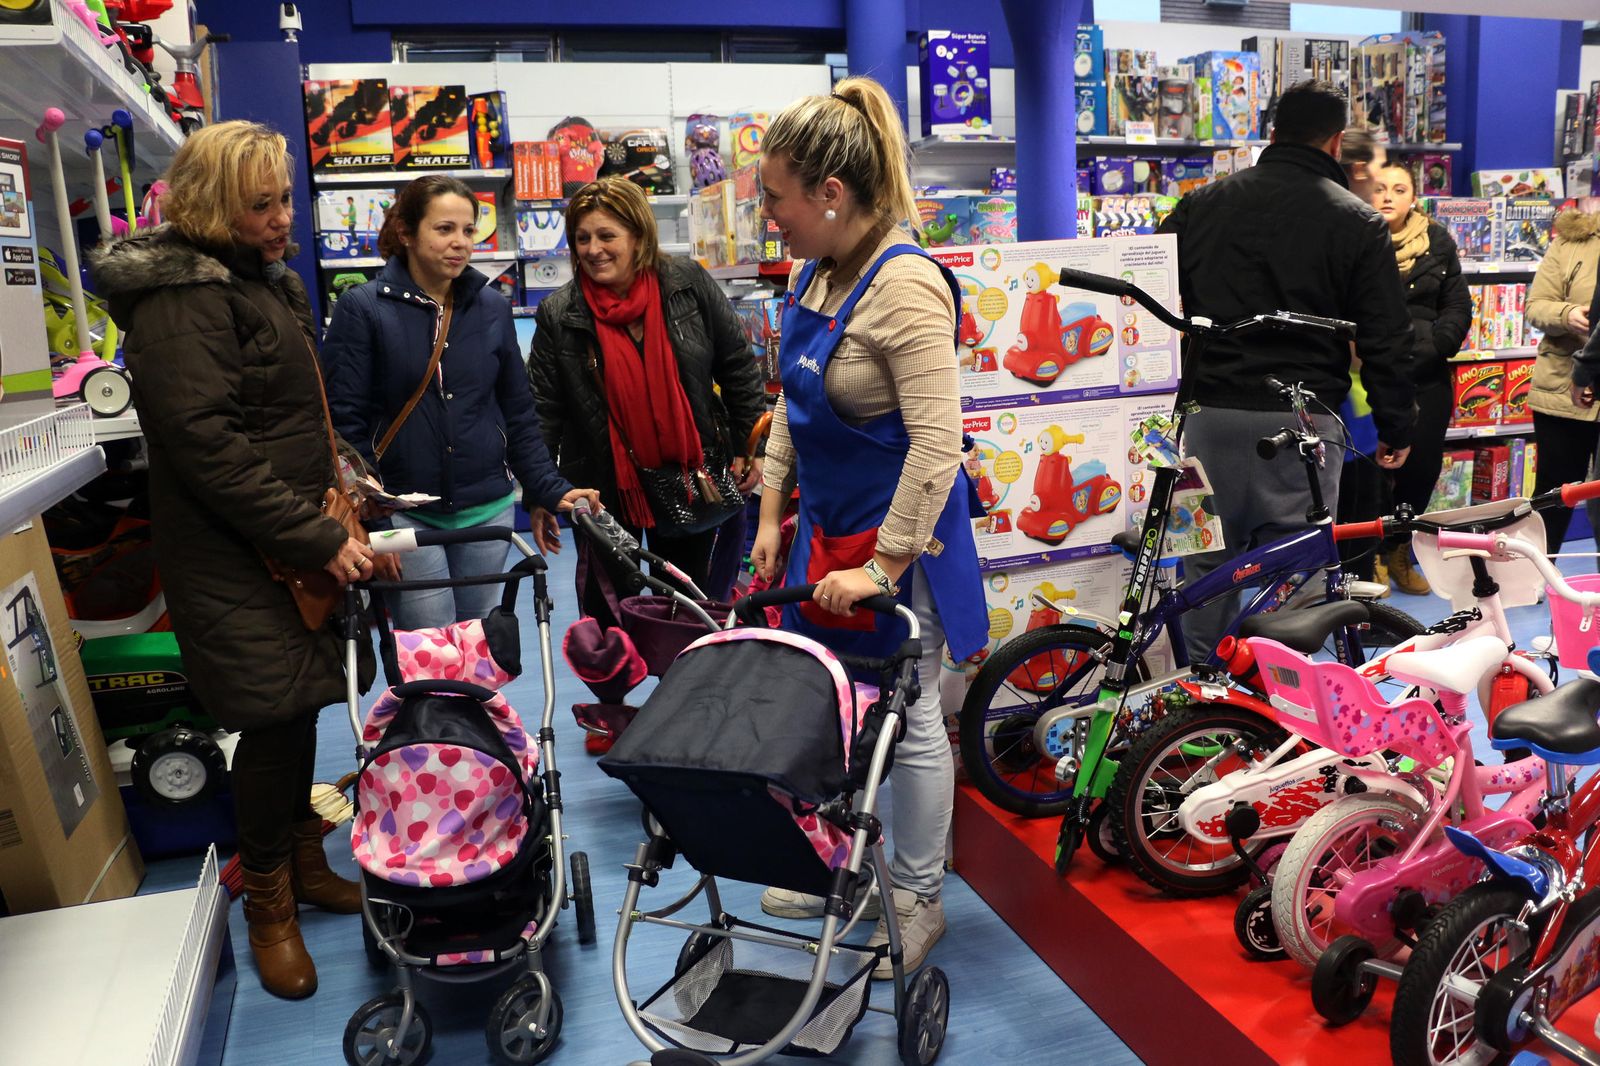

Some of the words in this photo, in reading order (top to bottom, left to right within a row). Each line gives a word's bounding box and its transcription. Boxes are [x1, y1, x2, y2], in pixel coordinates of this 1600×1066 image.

[1, 152, 21, 161] SMOBY
[333, 155, 391, 165] SKATES
[414, 155, 468, 165] SKATES
[1439, 205, 1488, 214] MONOPOLY
[1506, 205, 1556, 220] BATTLESHIP
[766, 241, 776, 259] 150
[1458, 367, 1478, 385] UNO
[1507, 365, 1528, 382] UNO
[963, 421, 988, 429] her-Price
[1131, 528, 1158, 598] TORPEDO
[88, 672, 165, 690] TRAC
[146, 685, 186, 695] AGROLAND
[67, 712, 81, 750] Soccer
[79, 753, 93, 782] Table
